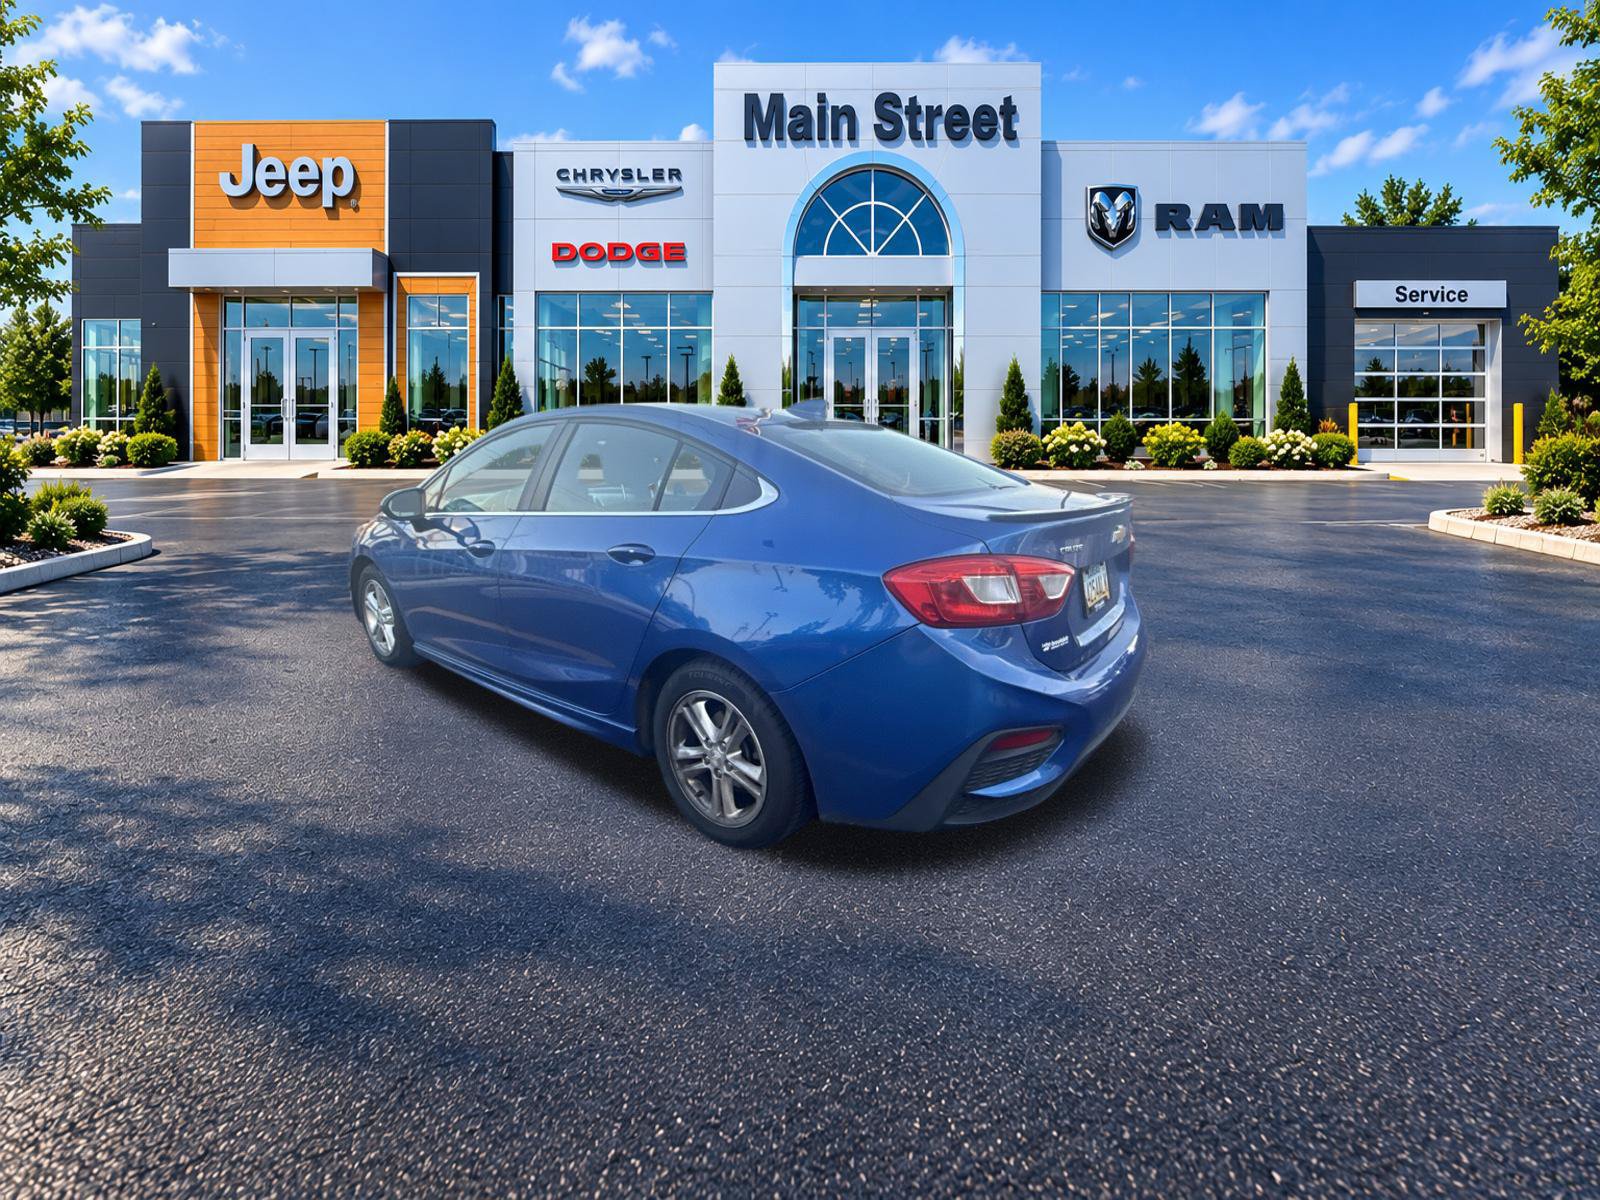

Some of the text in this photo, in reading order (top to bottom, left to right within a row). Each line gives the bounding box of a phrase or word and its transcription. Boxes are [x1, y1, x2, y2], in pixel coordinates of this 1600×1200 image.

[744, 91, 1018, 141] Main Street
[219, 143, 354, 208] Jeep
[556, 168, 682, 182] CHRYSLER
[1155, 203, 1284, 231] RAM
[552, 242, 686, 262] DODGE
[1395, 285, 1469, 303] Service
